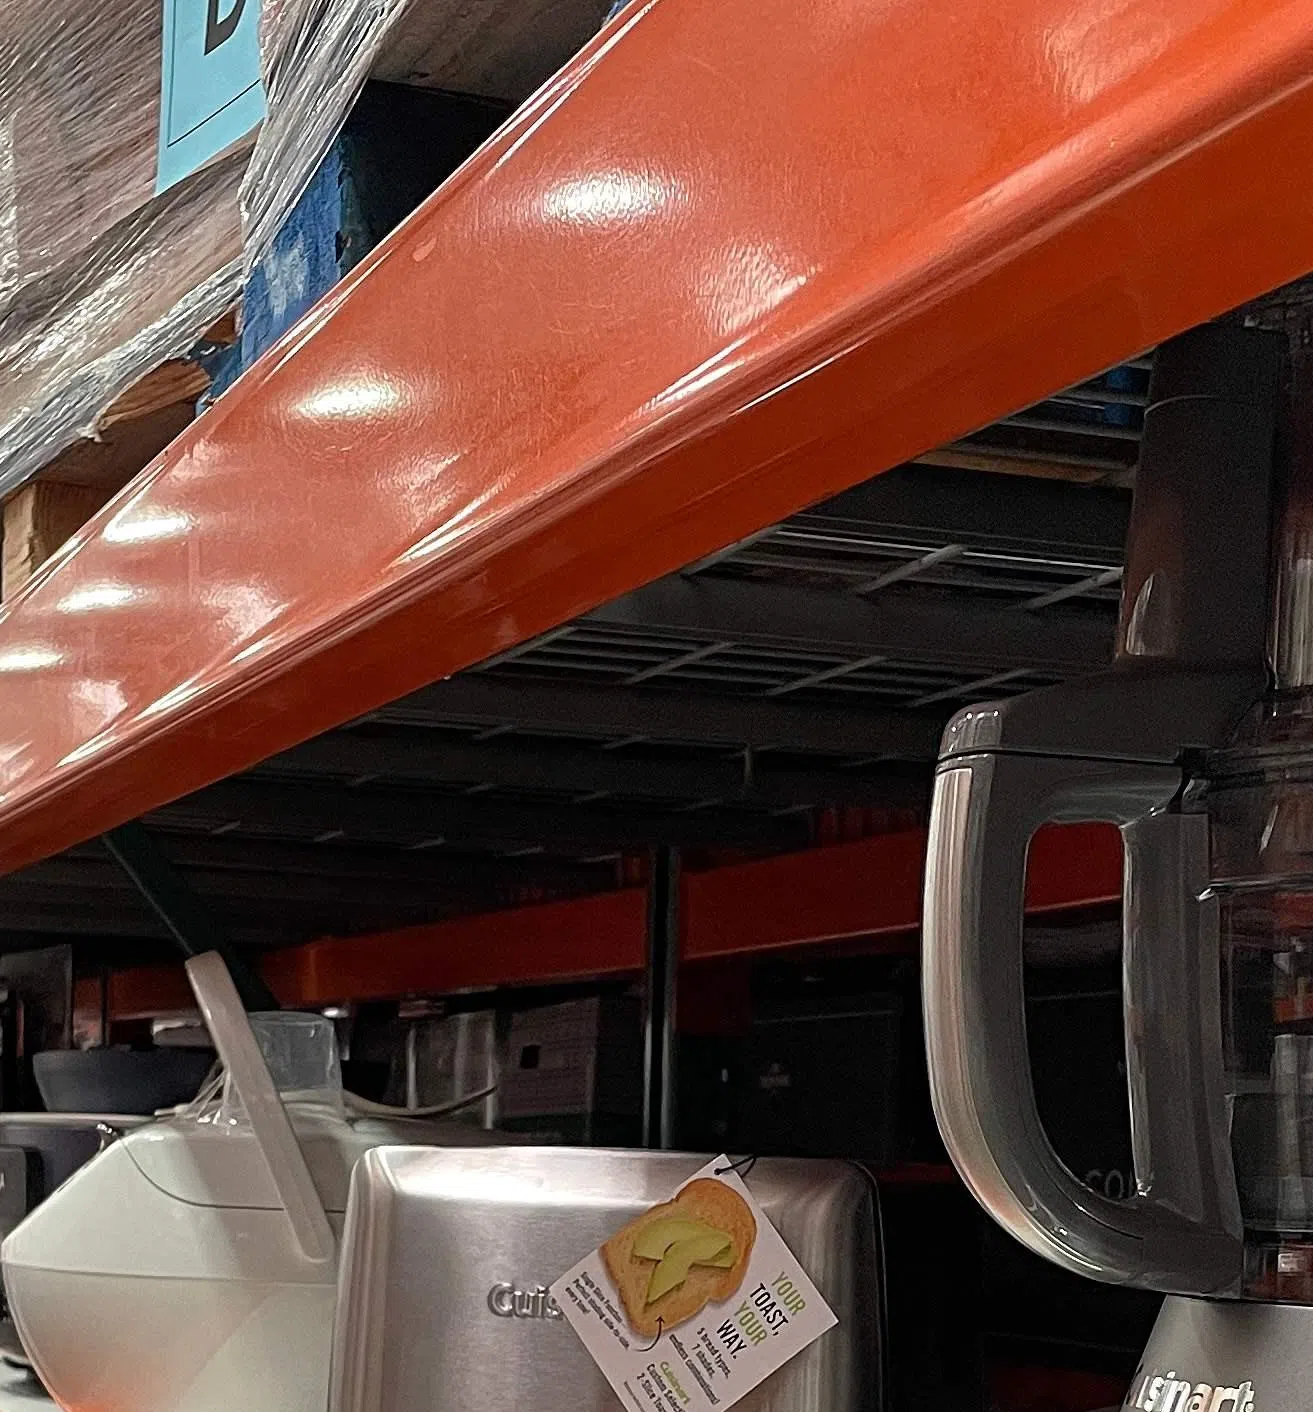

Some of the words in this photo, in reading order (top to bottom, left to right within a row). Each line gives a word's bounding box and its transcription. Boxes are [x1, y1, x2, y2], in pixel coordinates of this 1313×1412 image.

[750, 1283, 789, 1336] TOAST,
[771, 1271, 806, 1316] YOUR
[716, 1319, 747, 1359] WAY.
[734, 1300, 767, 1346] YOUR
[647, 1364, 667, 1392] Custom
